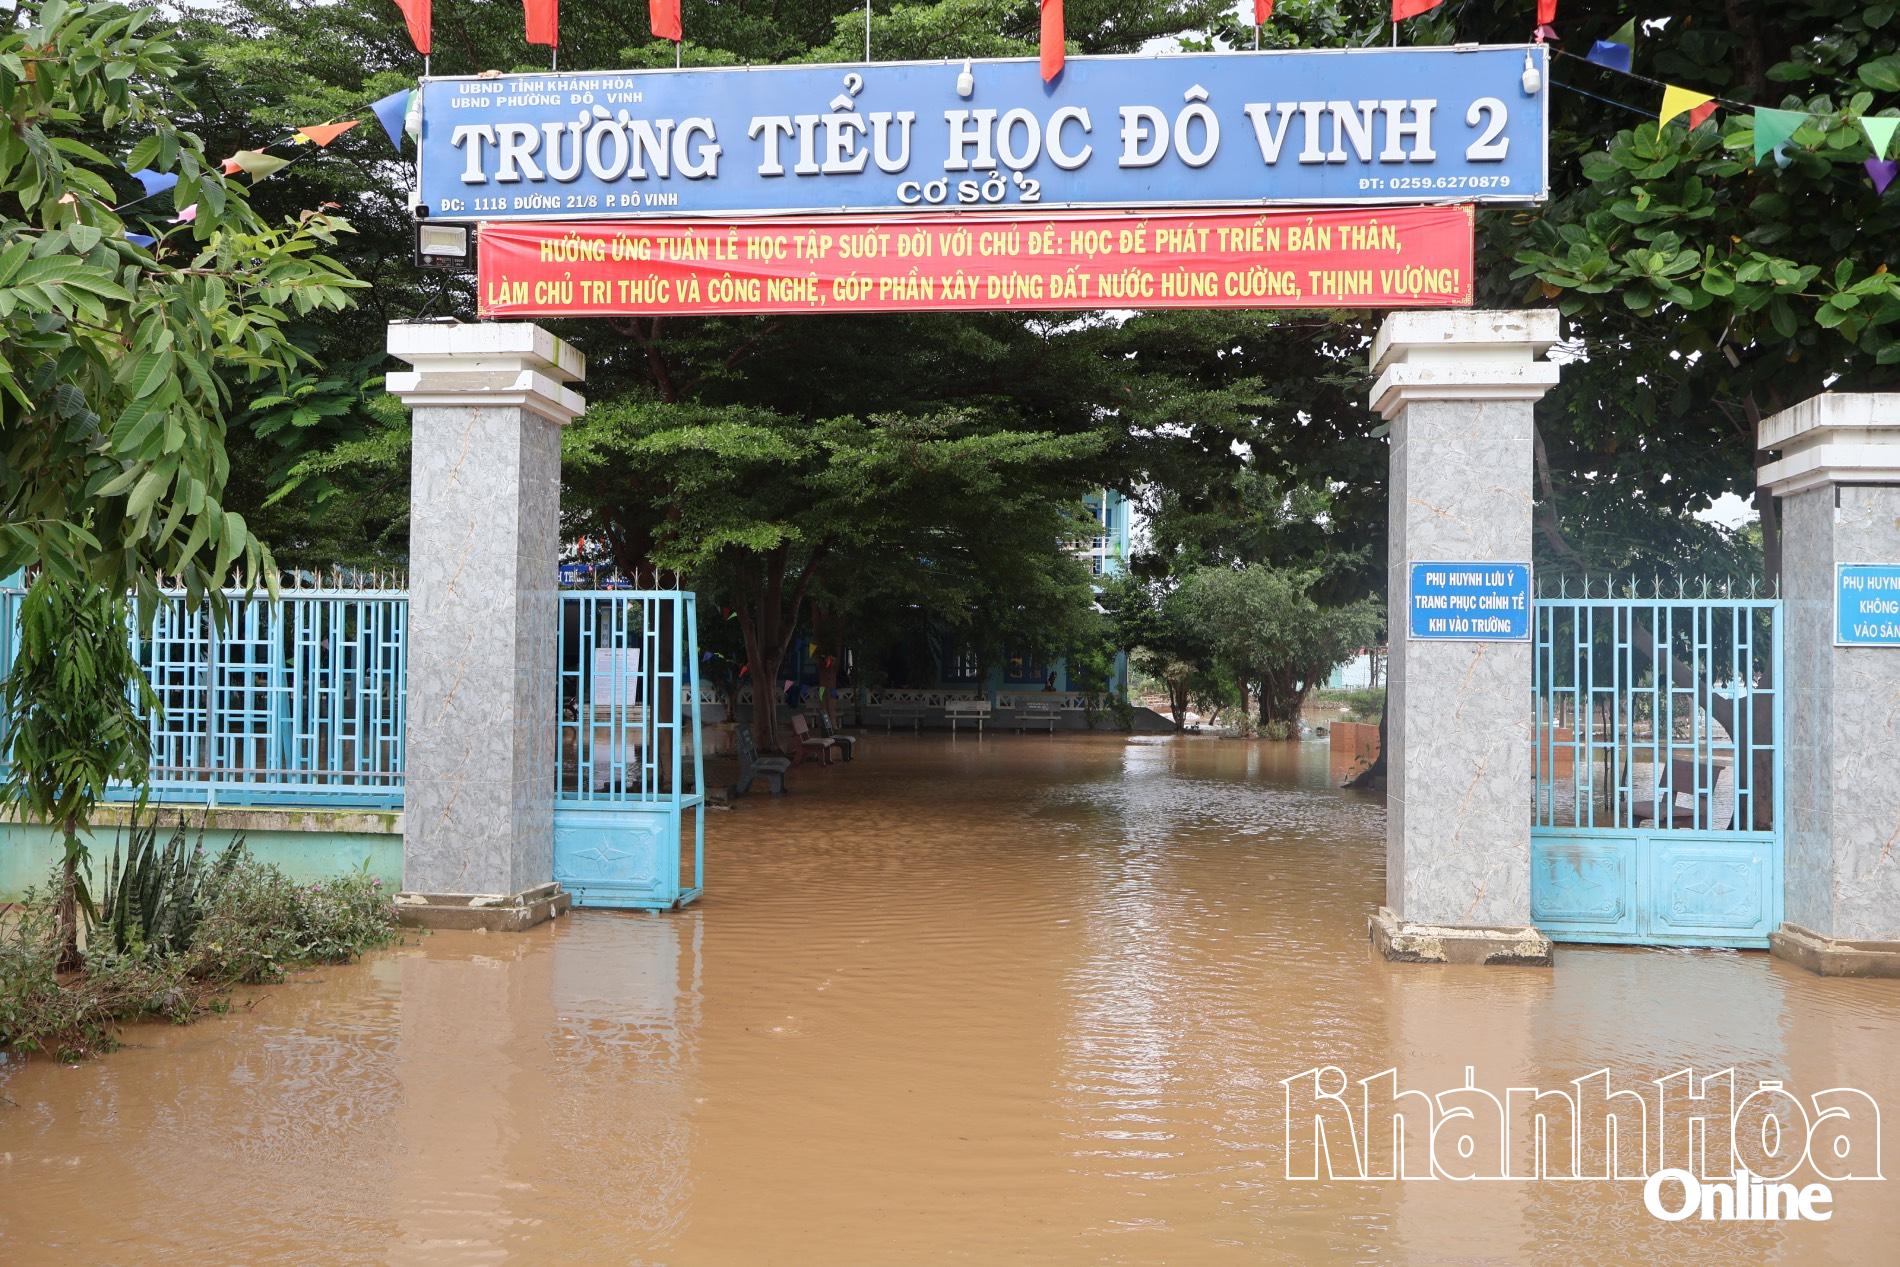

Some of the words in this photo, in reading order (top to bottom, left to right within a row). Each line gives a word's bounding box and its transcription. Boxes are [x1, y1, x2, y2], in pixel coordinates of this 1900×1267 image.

[460, 83, 503, 94] UBND
[548, 79, 599, 91] KHÁNH
[602, 78, 634, 90] HÒA
[451, 97, 490, 108] UBND
[496, 93, 561, 107] PHƯỜNG
[570, 91, 594, 105] ĐÔ
[607, 92, 643, 104] VINH
[451, 104, 722, 184] TRƯỜNG
[748, 73, 917, 176] TIỂU
[944, 106, 1093, 184] HỌC
[1118, 84, 1220, 168] ĐÔ
[1244, 99, 1437, 165] VINH
[1465, 97, 1511, 162] 2
[1019, 179, 1041, 203] 2
[1358, 178, 1384, 190] ĐT:
[1390, 176, 1511, 189] 0259.6270879
[441, 198, 465, 211] ĐC:
[474, 198, 507, 211] 1118
[513, 192, 561, 210] ĐƯỜNG
[566, 195, 598, 208] 21/8
[620, 191, 641, 207] ĐÔ
[644, 193, 678, 206] VINH
[540, 230, 606, 262] HƯỞNG
[611, 232, 651, 262] ỨNG
[656, 227, 708, 261] TUẦN
[715, 226, 739, 260] LỄ
[746, 235, 787, 264] HỌC
[793, 229, 833, 264] TẬP
[838, 224, 891, 259] SUỐT
[897, 227, 932, 257] ĐỜI
[939, 226, 972, 257] VỚI
[979, 223, 1021, 256] CHỦ
[1028, 222, 1063, 255] ĐỀ:
[1070, 229, 1112, 260] HỌC
[1119, 219, 1147, 254] ĐỂ
[1155, 222, 1209, 253] PHÁT
[1217, 215, 1280, 252] TRIỂN
[1287, 216, 1332, 251] BẢN
[1338, 219, 1402, 255] THÂN,
[488, 276, 529, 305] LÀM
[534, 272, 573, 304] CHỦ
[580, 281, 612, 304] TRI
[618, 274, 671, 304] THỨC
[676, 273, 701, 303] VÀ
[707, 273, 761, 303] CÔNG
[767, 272, 826, 306] NGHỆ,
[832, 271, 873, 301] GÓP
[880, 265, 934, 301] PHẦN
[940, 269, 980, 300] XÂY
[987, 271, 1043, 304] DỰNG
[1050, 264, 1091, 298] ĐẤT
[1098, 264, 1154, 298] NƯỚC
[1161, 268, 1218, 297] HÙNG
[1224, 265, 1302, 300] CƯỜNG,
[1308, 269, 1373, 300] THỊNH
[1380, 264, 1460, 299] VƯỢNG!
[1426, 572, 1446, 588] PHỤ
[1449, 573, 1482, 586] HUYNH
[1507, 570, 1514, 586] Ý
[1843, 576, 1864, 591] PHỤ
[1415, 595, 1447, 609] TRANG
[1450, 596, 1476, 612] PHỤC
[1479, 592, 1509, 610] CHỈNH
[1512, 591, 1525, 610] TỀ
[1860, 597, 1899, 614] KHÔNG
[1429, 619, 1446, 632] KHI
[1449, 616, 1469, 632] VÀO
[1471, 616, 1511, 633] TRƯỜNG
[1853, 620, 1877, 637] VÀO
